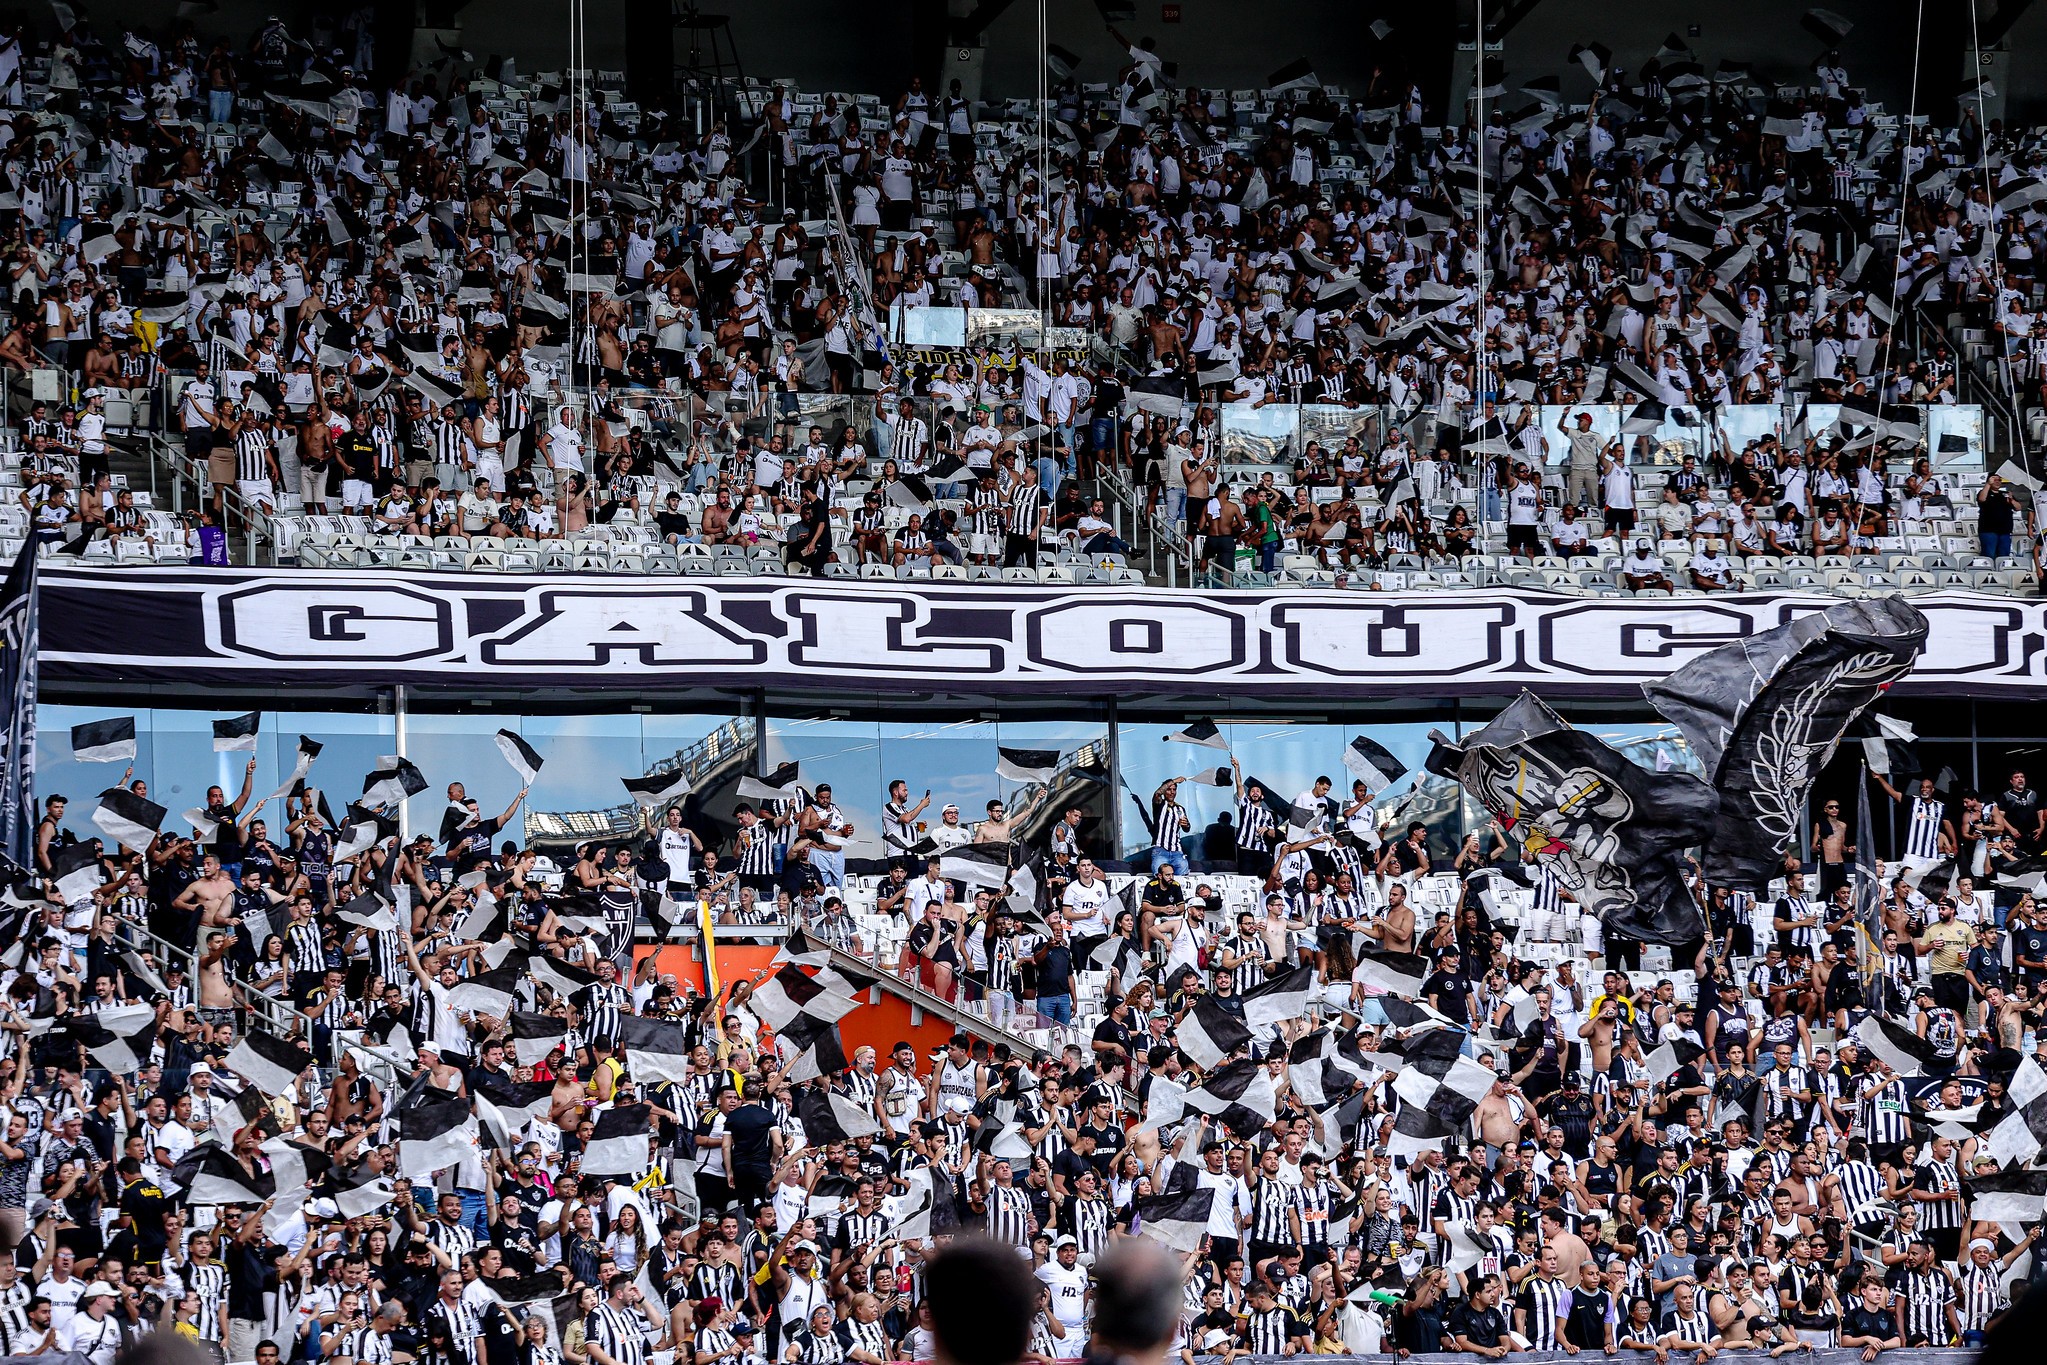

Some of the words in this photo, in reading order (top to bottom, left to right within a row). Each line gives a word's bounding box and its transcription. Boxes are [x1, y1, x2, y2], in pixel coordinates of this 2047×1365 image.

[1164, 10, 1178, 18] 339
[28, 1113, 39, 1129] 13
[1304, 1209, 1328, 1222] BMG
[1482, 1256, 1499, 1273] FIAT
